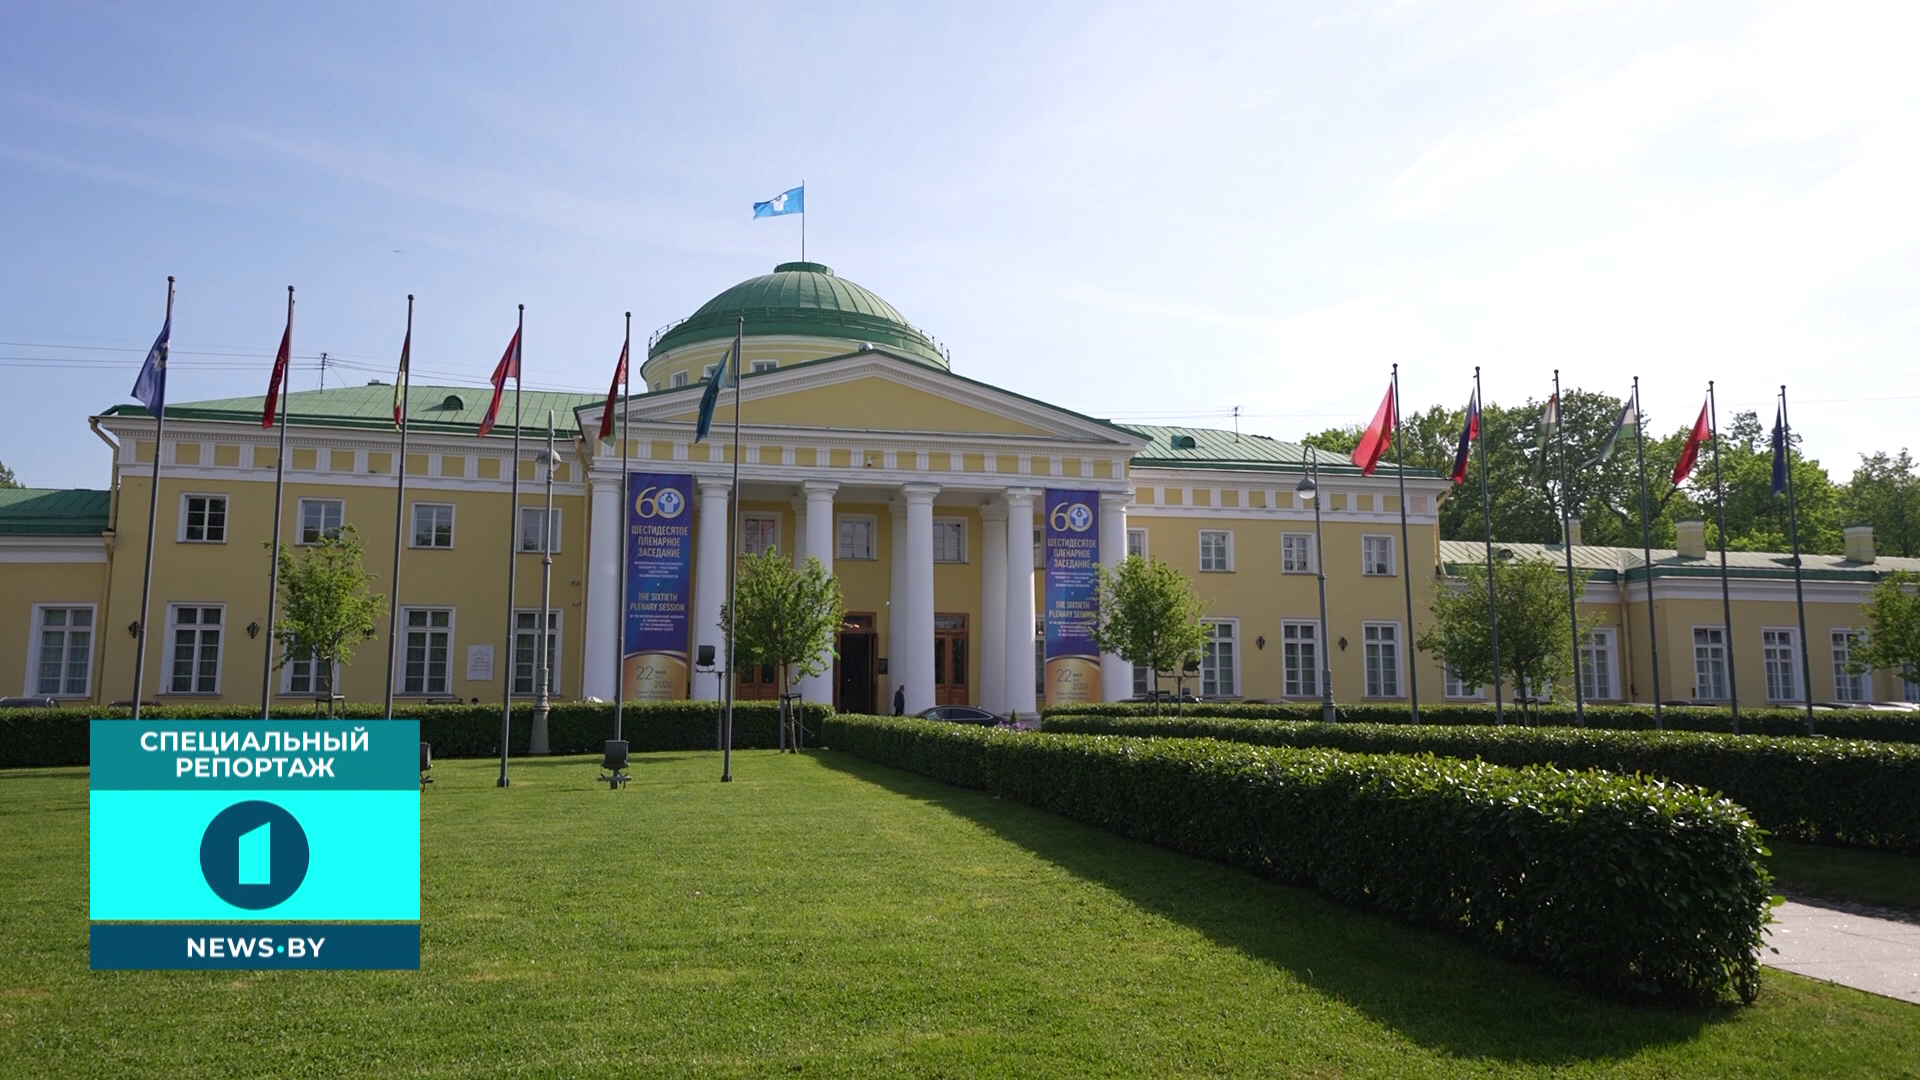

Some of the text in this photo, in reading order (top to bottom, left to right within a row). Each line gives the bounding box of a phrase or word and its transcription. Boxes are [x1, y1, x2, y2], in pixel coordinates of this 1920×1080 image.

[635, 486, 685, 519] 60
[1050, 502, 1093, 532] 60
[631, 525, 688, 536] ШЕСТИДЕСЯТОЕ
[638, 536, 681, 547] ПЛЕНАРНОЕ
[1047, 538, 1097, 548] ШЕСТИДЕСЯТОЕ
[638, 548, 681, 558] ЗАСЕДАНИЕ
[1054, 549, 1090, 558] ПЛЕНАРНОЕ
[1053, 559, 1091, 569] ЗАСЕДАНИЕ
[638, 593, 678, 601] THE SIXTIETH
[630, 603, 685, 612] PLENARY SESSION
[1055, 601, 1090, 609] THE SIXTIETH
[1049, 610, 1073, 618] PLENARY
[636, 665, 653, 680] 22
[1056, 669, 1072, 682] 22
